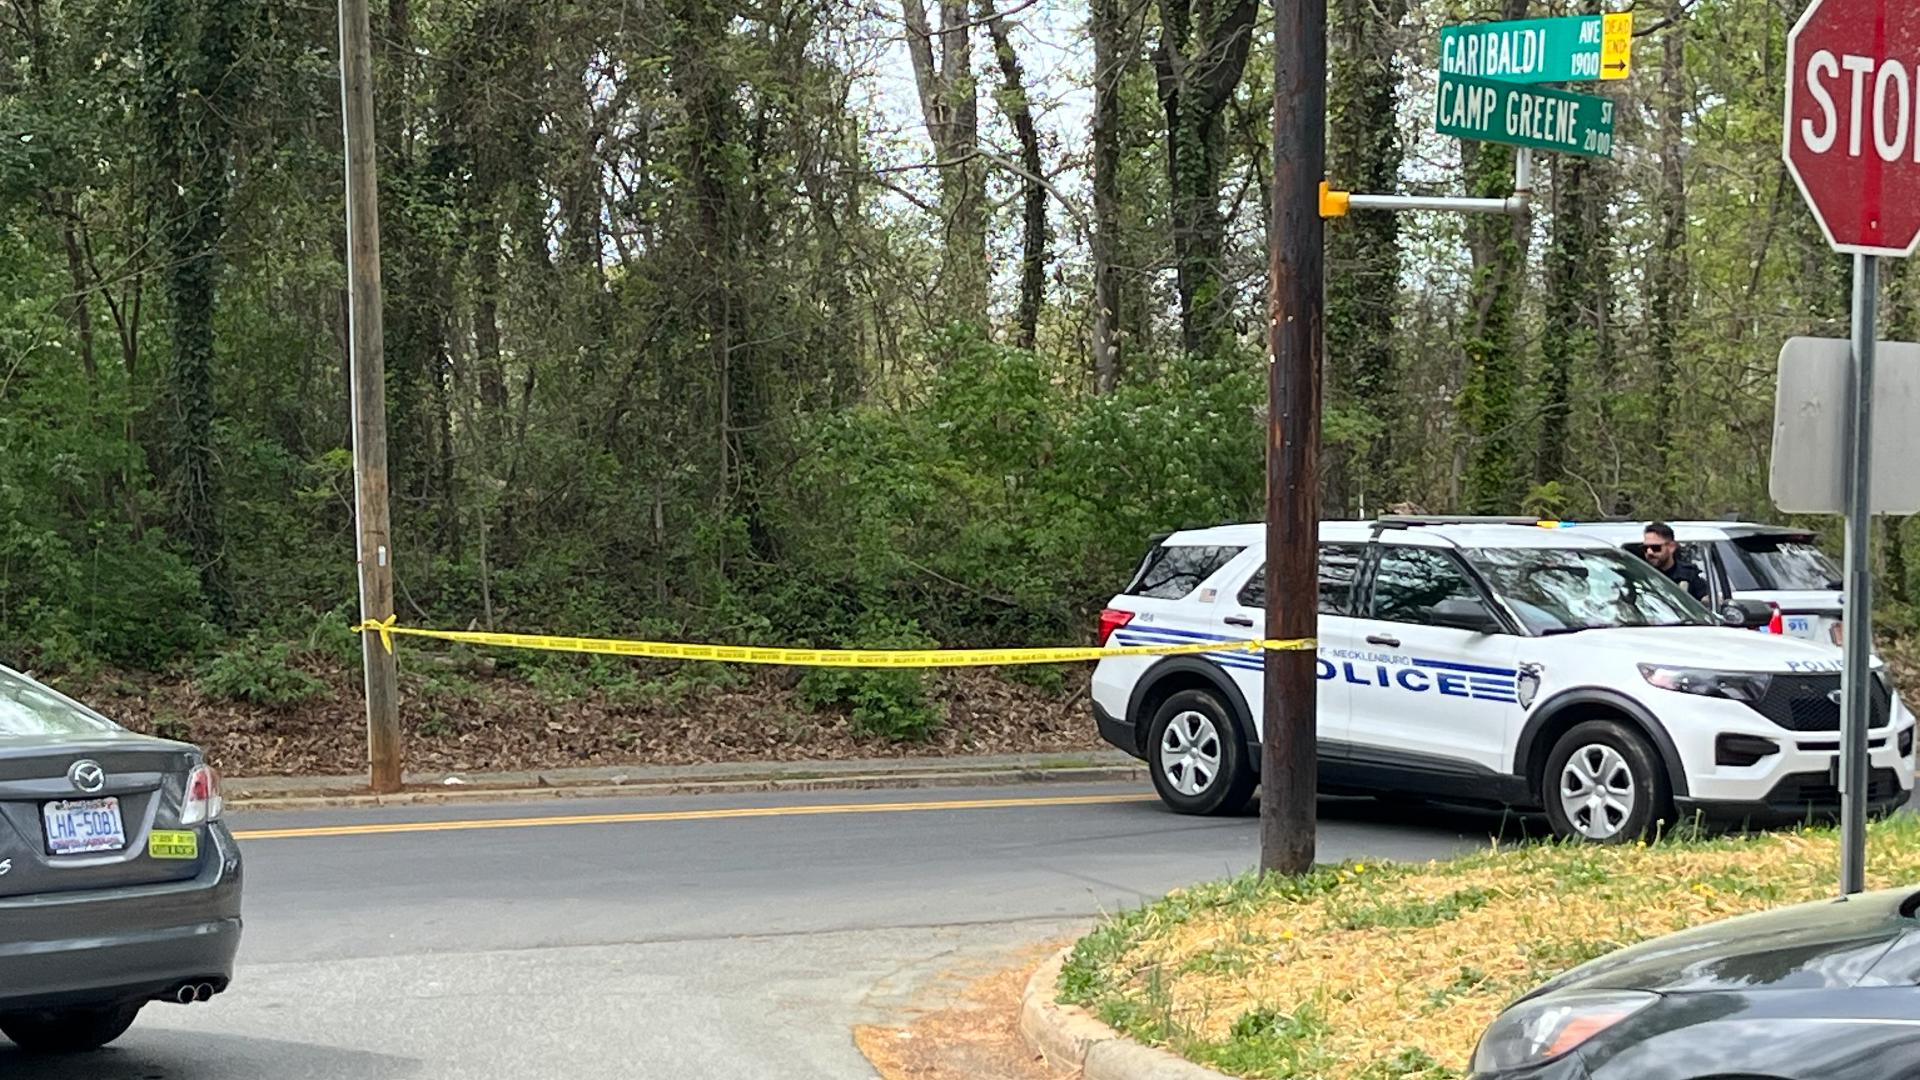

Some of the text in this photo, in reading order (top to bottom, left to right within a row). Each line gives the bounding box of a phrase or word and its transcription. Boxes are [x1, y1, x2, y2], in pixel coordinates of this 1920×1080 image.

[1442, 20, 1600, 76] GARIBALDI AVE
[1571, 52, 1599, 76] 1900
[1439, 81, 1613, 145] CAMP GREENE ST
[1801, 49, 1920, 163] STO
[1583, 129, 1611, 155] 2000
[1788, 621, 1808, 632] 911
[1316, 657, 1469, 698] OLICE
[1785, 660, 1843, 672] POLI
[46, 809, 120, 839] LHA-5081
